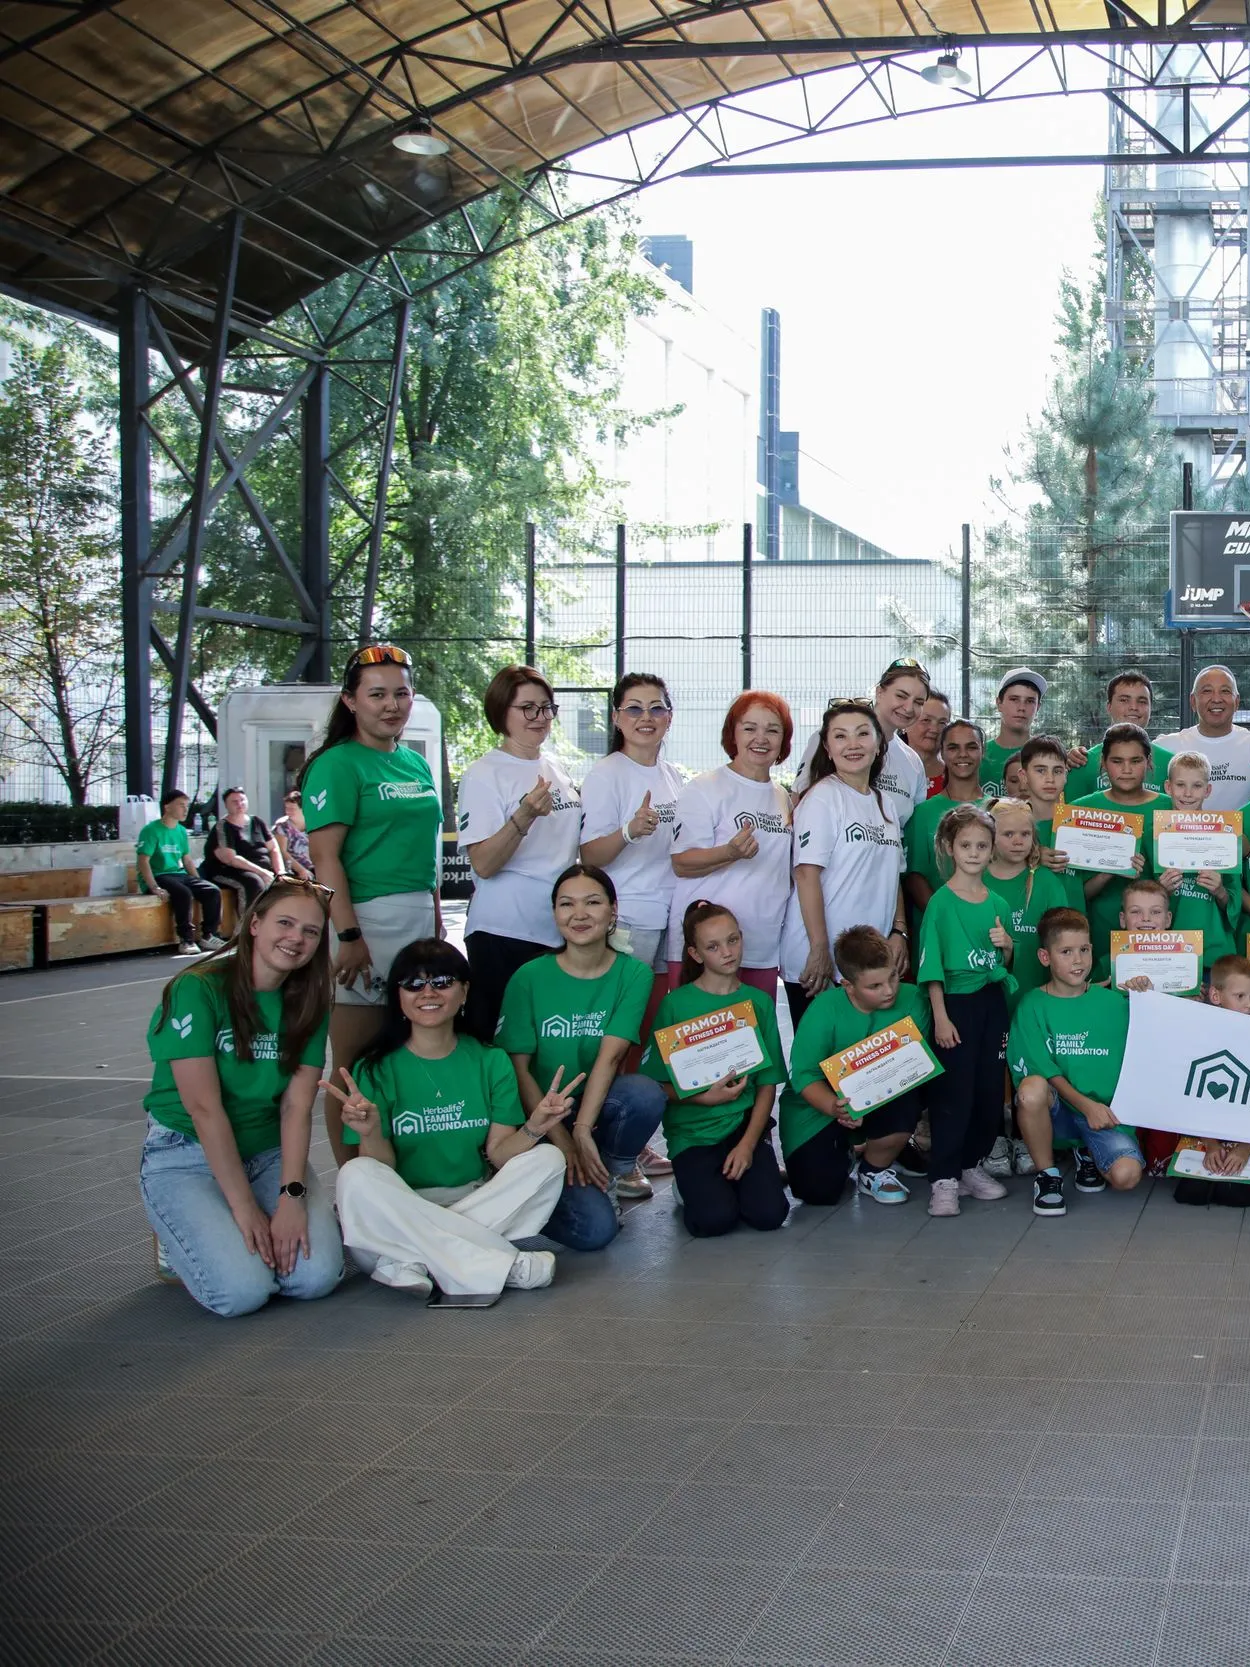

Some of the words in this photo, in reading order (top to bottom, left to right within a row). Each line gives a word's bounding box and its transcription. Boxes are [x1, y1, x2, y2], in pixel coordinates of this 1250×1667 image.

[1212, 763, 1227, 771] balife
[552, 802, 581, 812] NDATIO
[1071, 809, 1125, 824] ГРАМОТА
[1171, 813, 1225, 824] ГРАМОТА
[760, 825, 792, 834] FOUNDAT
[1080, 820, 1102, 829] FITNESS
[1128, 933, 1184, 943] ГРАМОТА
[675, 1010, 735, 1040] ГРАМОТА
[688, 1029, 714, 1043] FITNESS
[714, 1024, 727, 1036] DAY
[1056, 1033, 1085, 1041] Herbalife
[840, 1030, 897, 1065] ГРАМОТА
[1056, 1040, 1085, 1048] FAMILY
[855, 1050, 880, 1068] FITNESS
[879, 1043, 892, 1056] DAY
[1056, 1047, 1109, 1056] FOUNDATION
[423, 1105, 462, 1115] Herbalife
[425, 1111, 462, 1123] FAMILY
[426, 1119, 489, 1133] FOUNDATION
